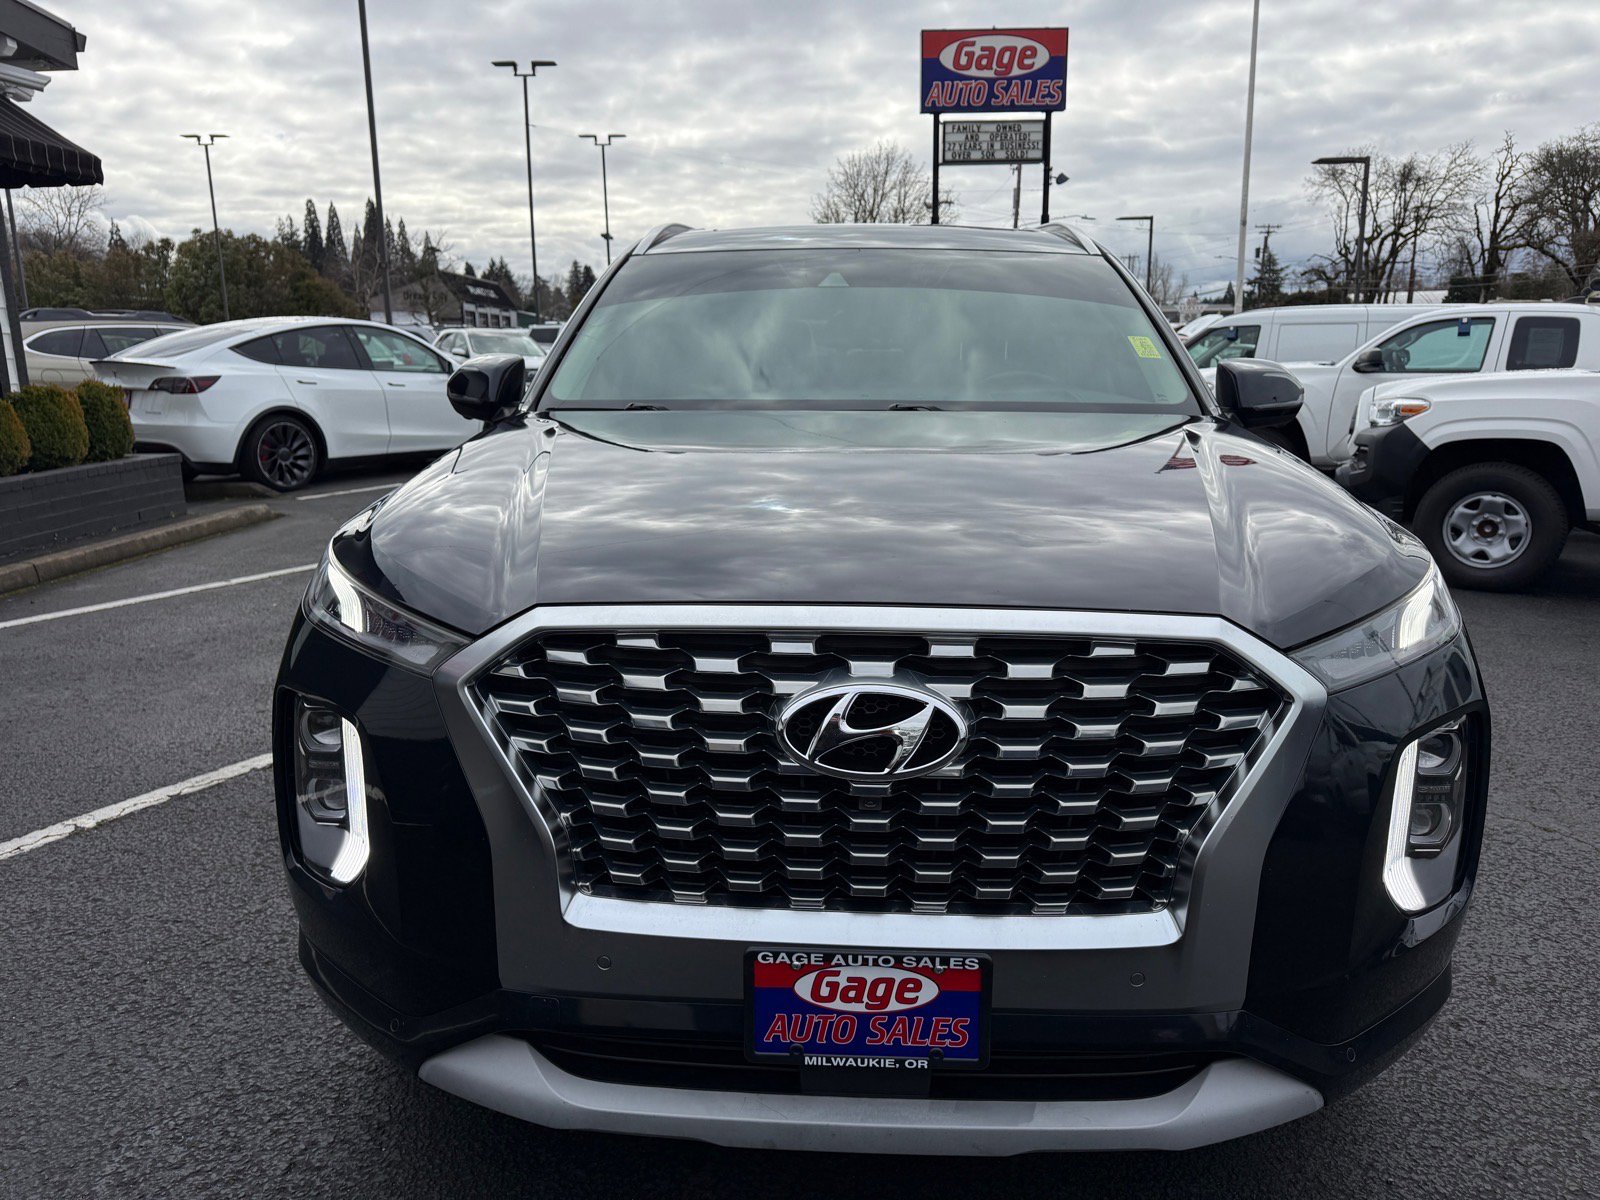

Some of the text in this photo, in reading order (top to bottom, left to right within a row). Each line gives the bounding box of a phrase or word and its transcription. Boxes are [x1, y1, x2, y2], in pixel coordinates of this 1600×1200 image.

[952, 40, 1038, 76] Gage
[925, 79, 1063, 107] AUTO SALES
[952, 123, 1022, 133] FAMILY OWNED
[965, 132, 1030, 142] AND OPERATED!
[959, 142, 982, 151] YEARS
[987, 142, 994, 150] IN
[1000, 141, 1039, 150] BUSINESS!
[952, 151, 971, 160] OVER
[1006, 150, 1028, 159] SOLD!
[757, 952, 980, 970] GAGE AUTO SALES
[810, 969, 923, 1010] Gage
[764, 1013, 971, 1048] AUTO SALES
[804, 1056, 928, 1069] MILWAUKIE, OR
